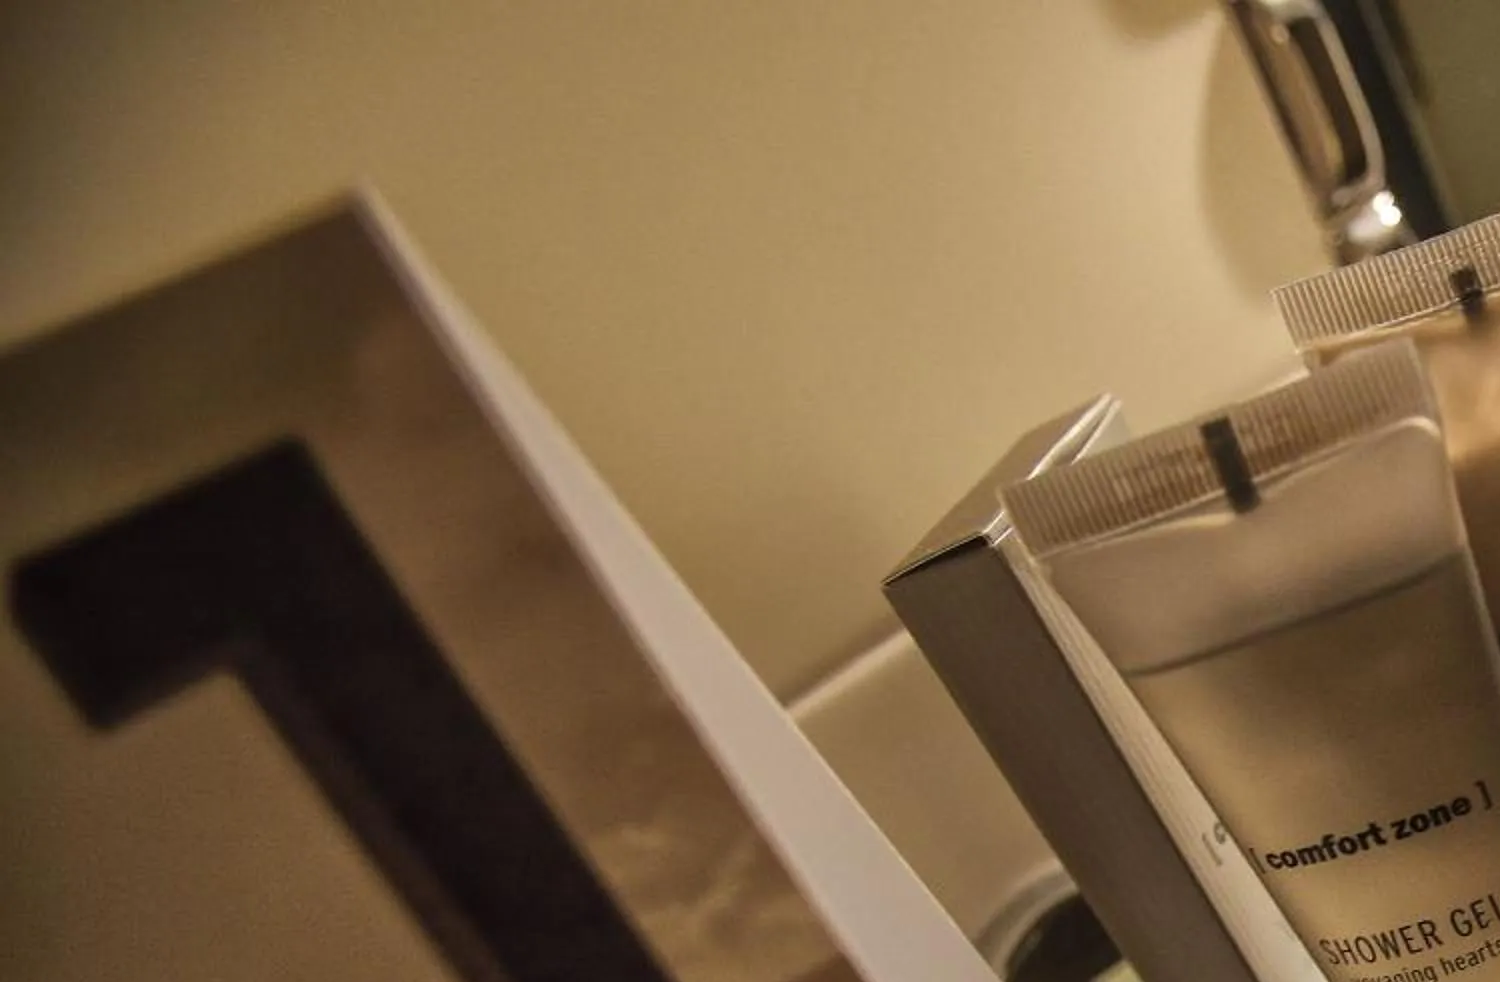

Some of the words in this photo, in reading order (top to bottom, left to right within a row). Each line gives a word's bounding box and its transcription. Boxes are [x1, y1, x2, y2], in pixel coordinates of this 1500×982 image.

[1265, 821, 1389, 871] comfort
[1392, 794, 1474, 842] zone
[1318, 917, 1446, 967] SHOWER
